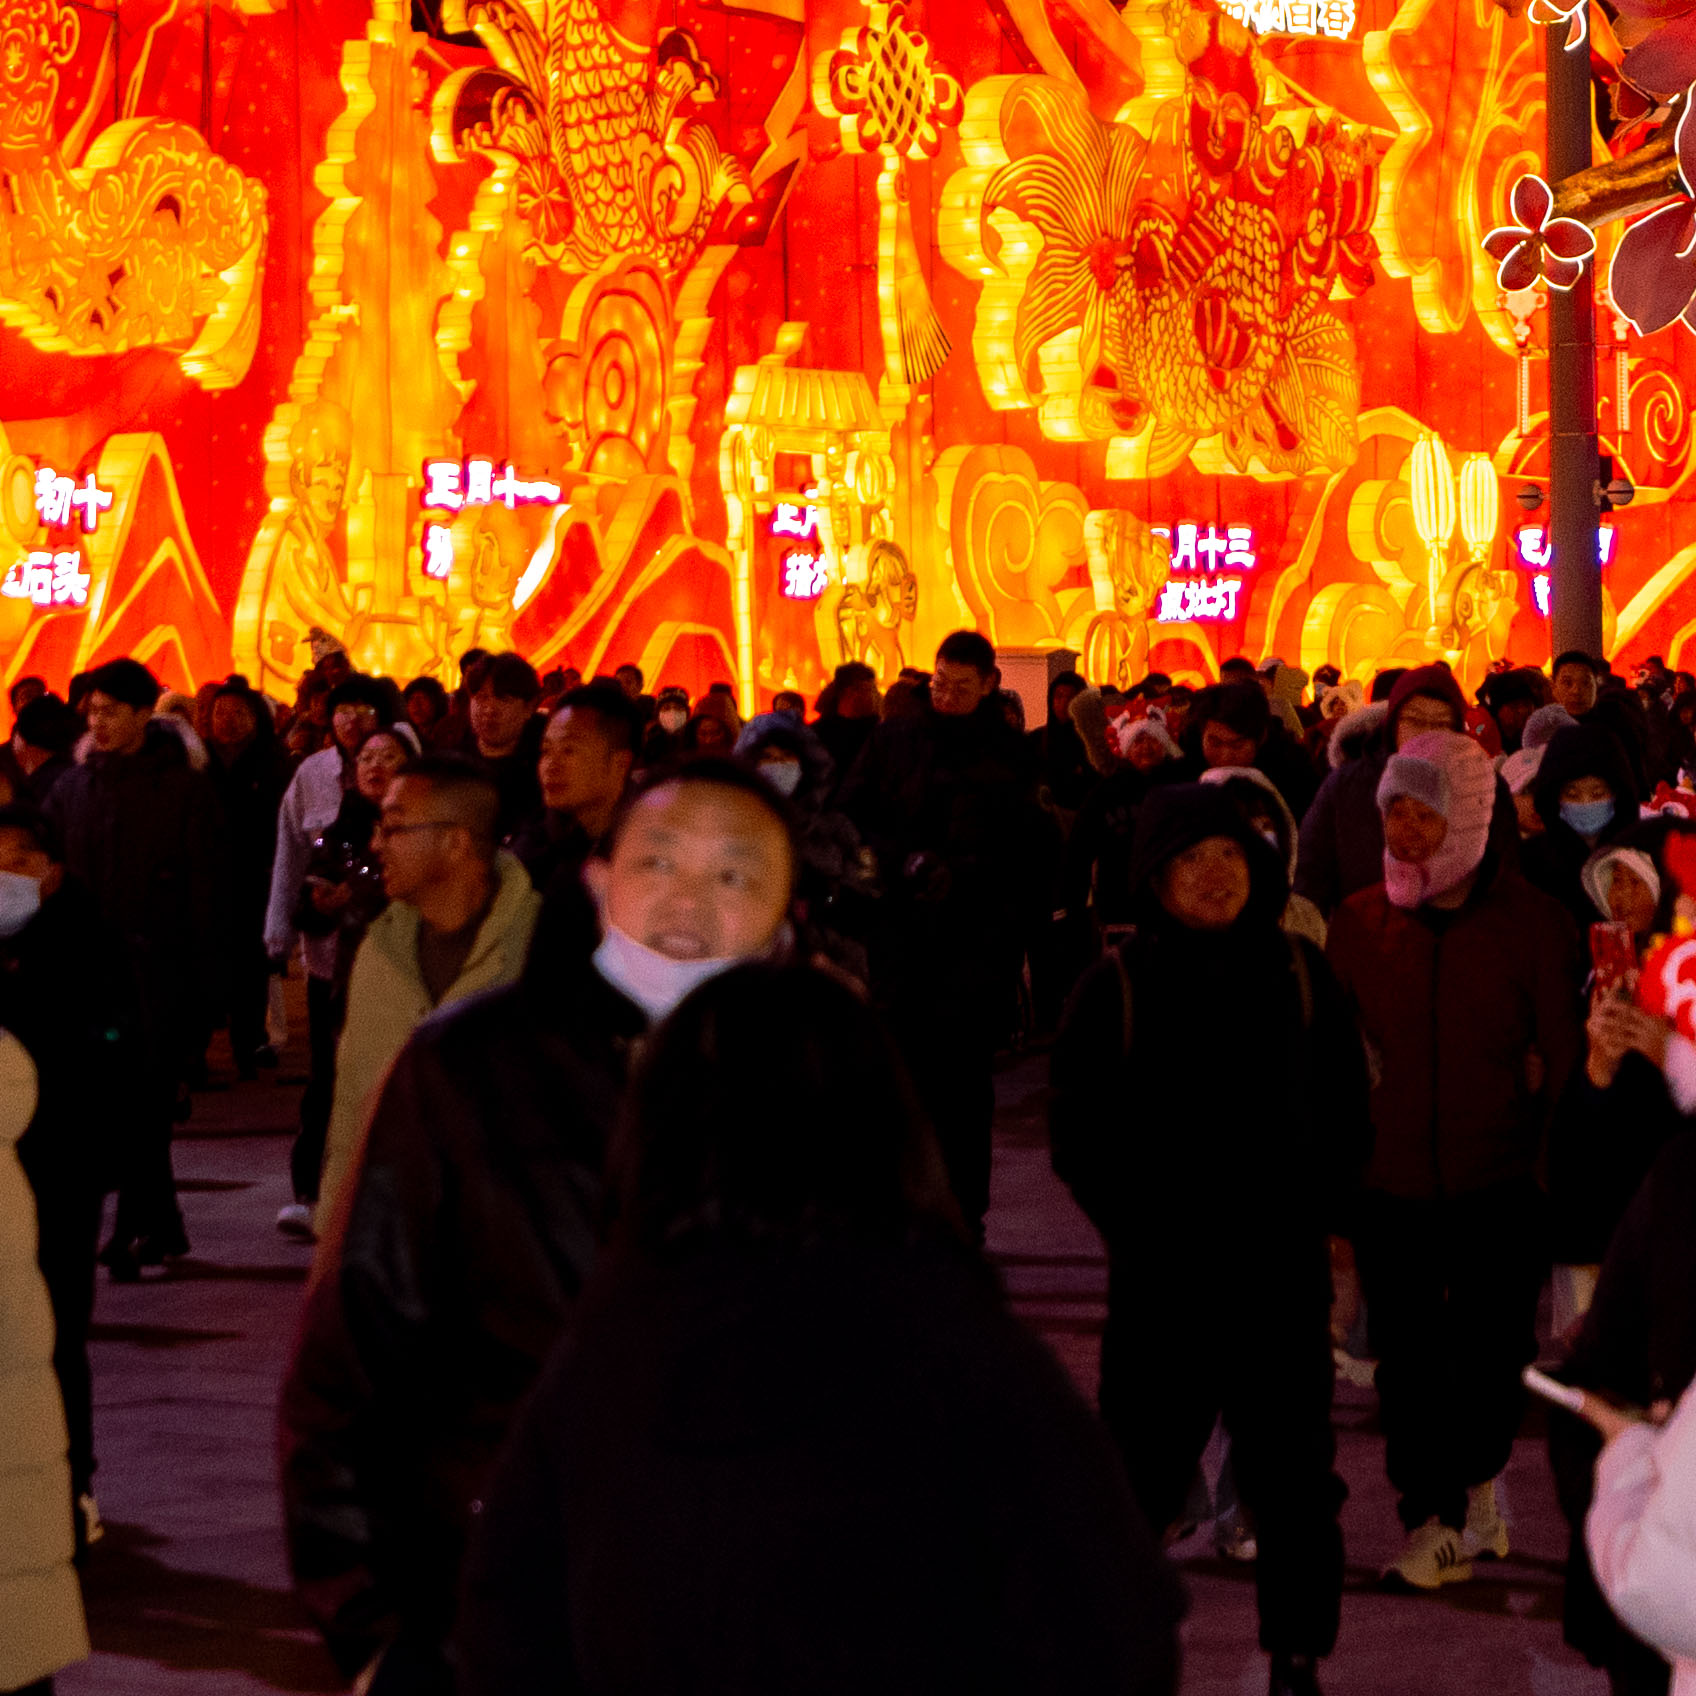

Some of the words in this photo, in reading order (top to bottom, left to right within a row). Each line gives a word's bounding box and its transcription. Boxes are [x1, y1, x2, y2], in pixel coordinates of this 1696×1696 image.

[424, 460, 561, 510] 正月十一
[1150, 523, 1256, 571] 月十三
